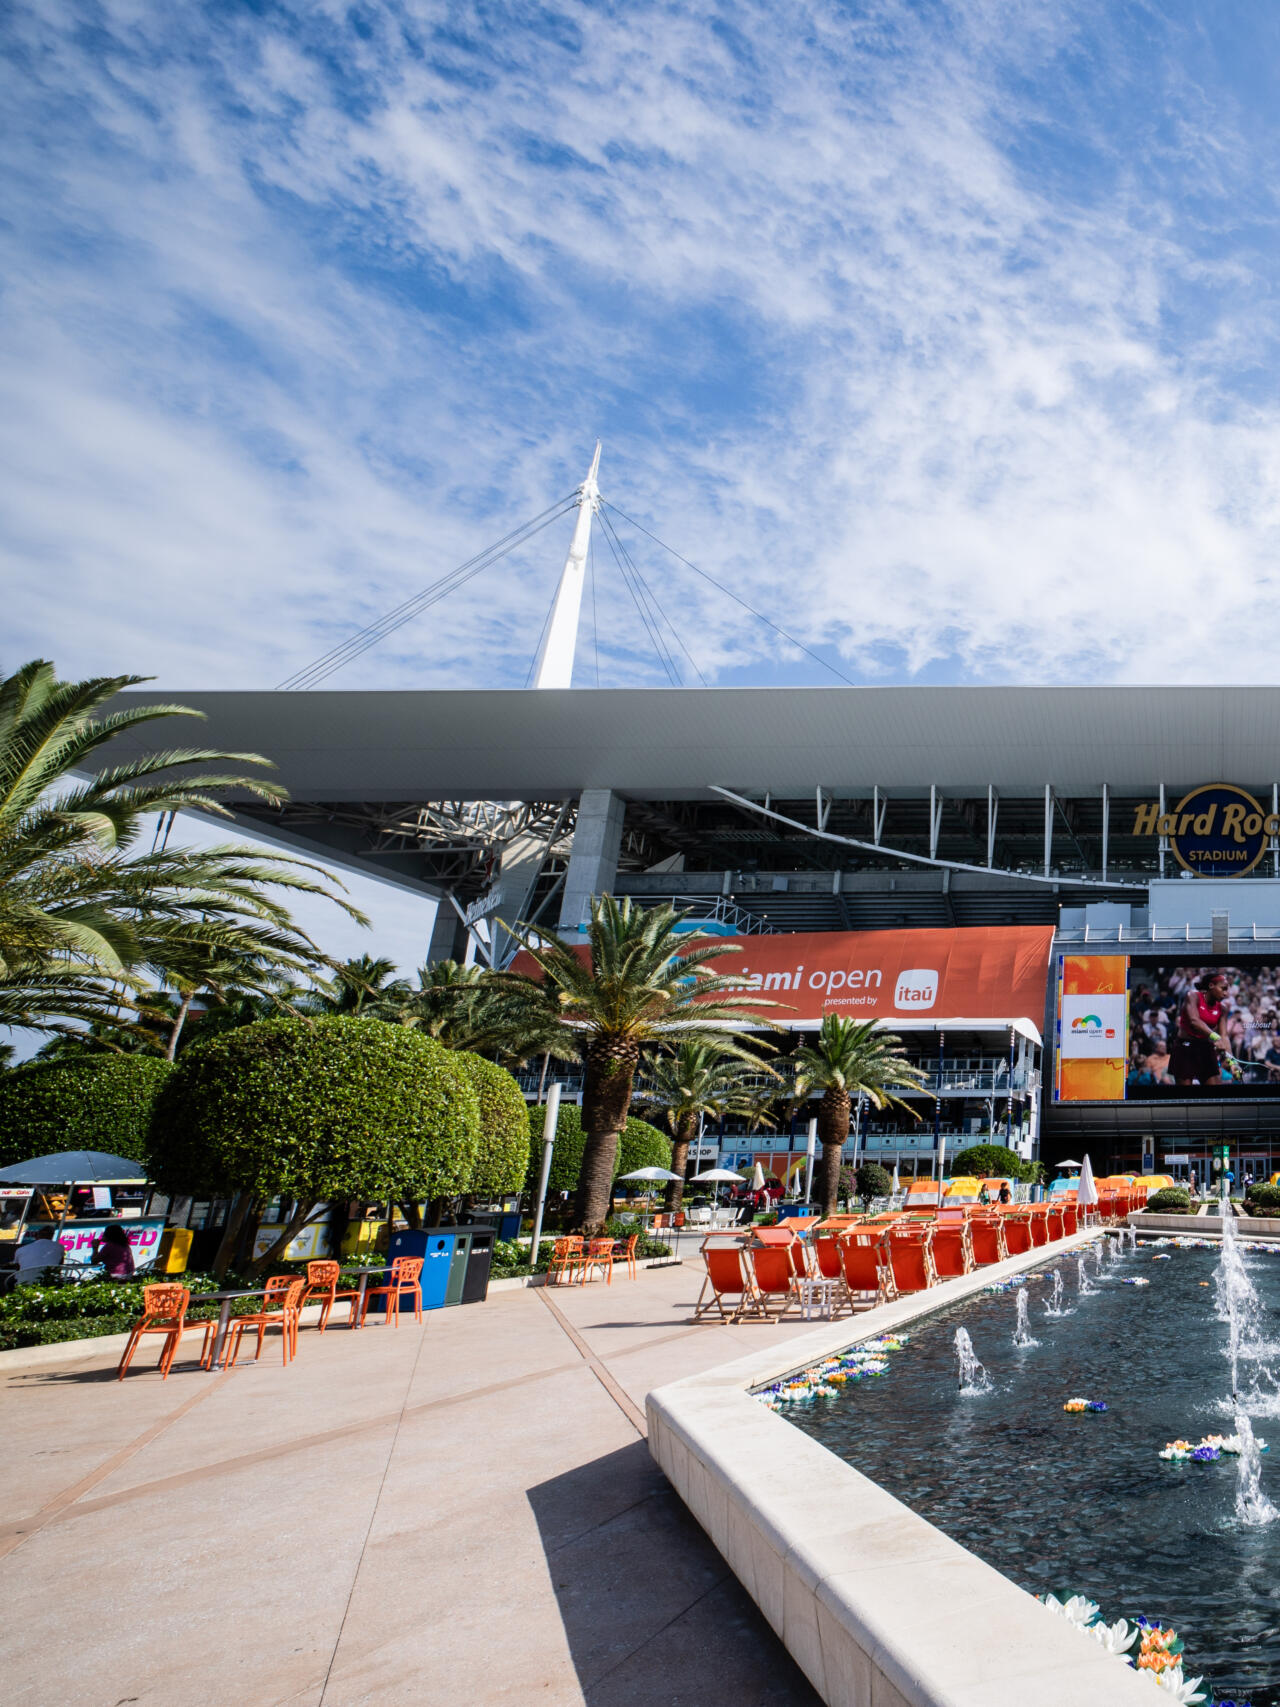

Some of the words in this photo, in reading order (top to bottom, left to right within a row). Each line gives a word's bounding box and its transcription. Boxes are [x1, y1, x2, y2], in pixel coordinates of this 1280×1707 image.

[1132, 803, 1218, 836] Hard
[1189, 850, 1248, 861] STADIUM
[808, 968, 882, 995] open
[824, 996, 865, 1007] presented
[866, 996, 877, 1006] by
[898, 986, 933, 1002] itaú
